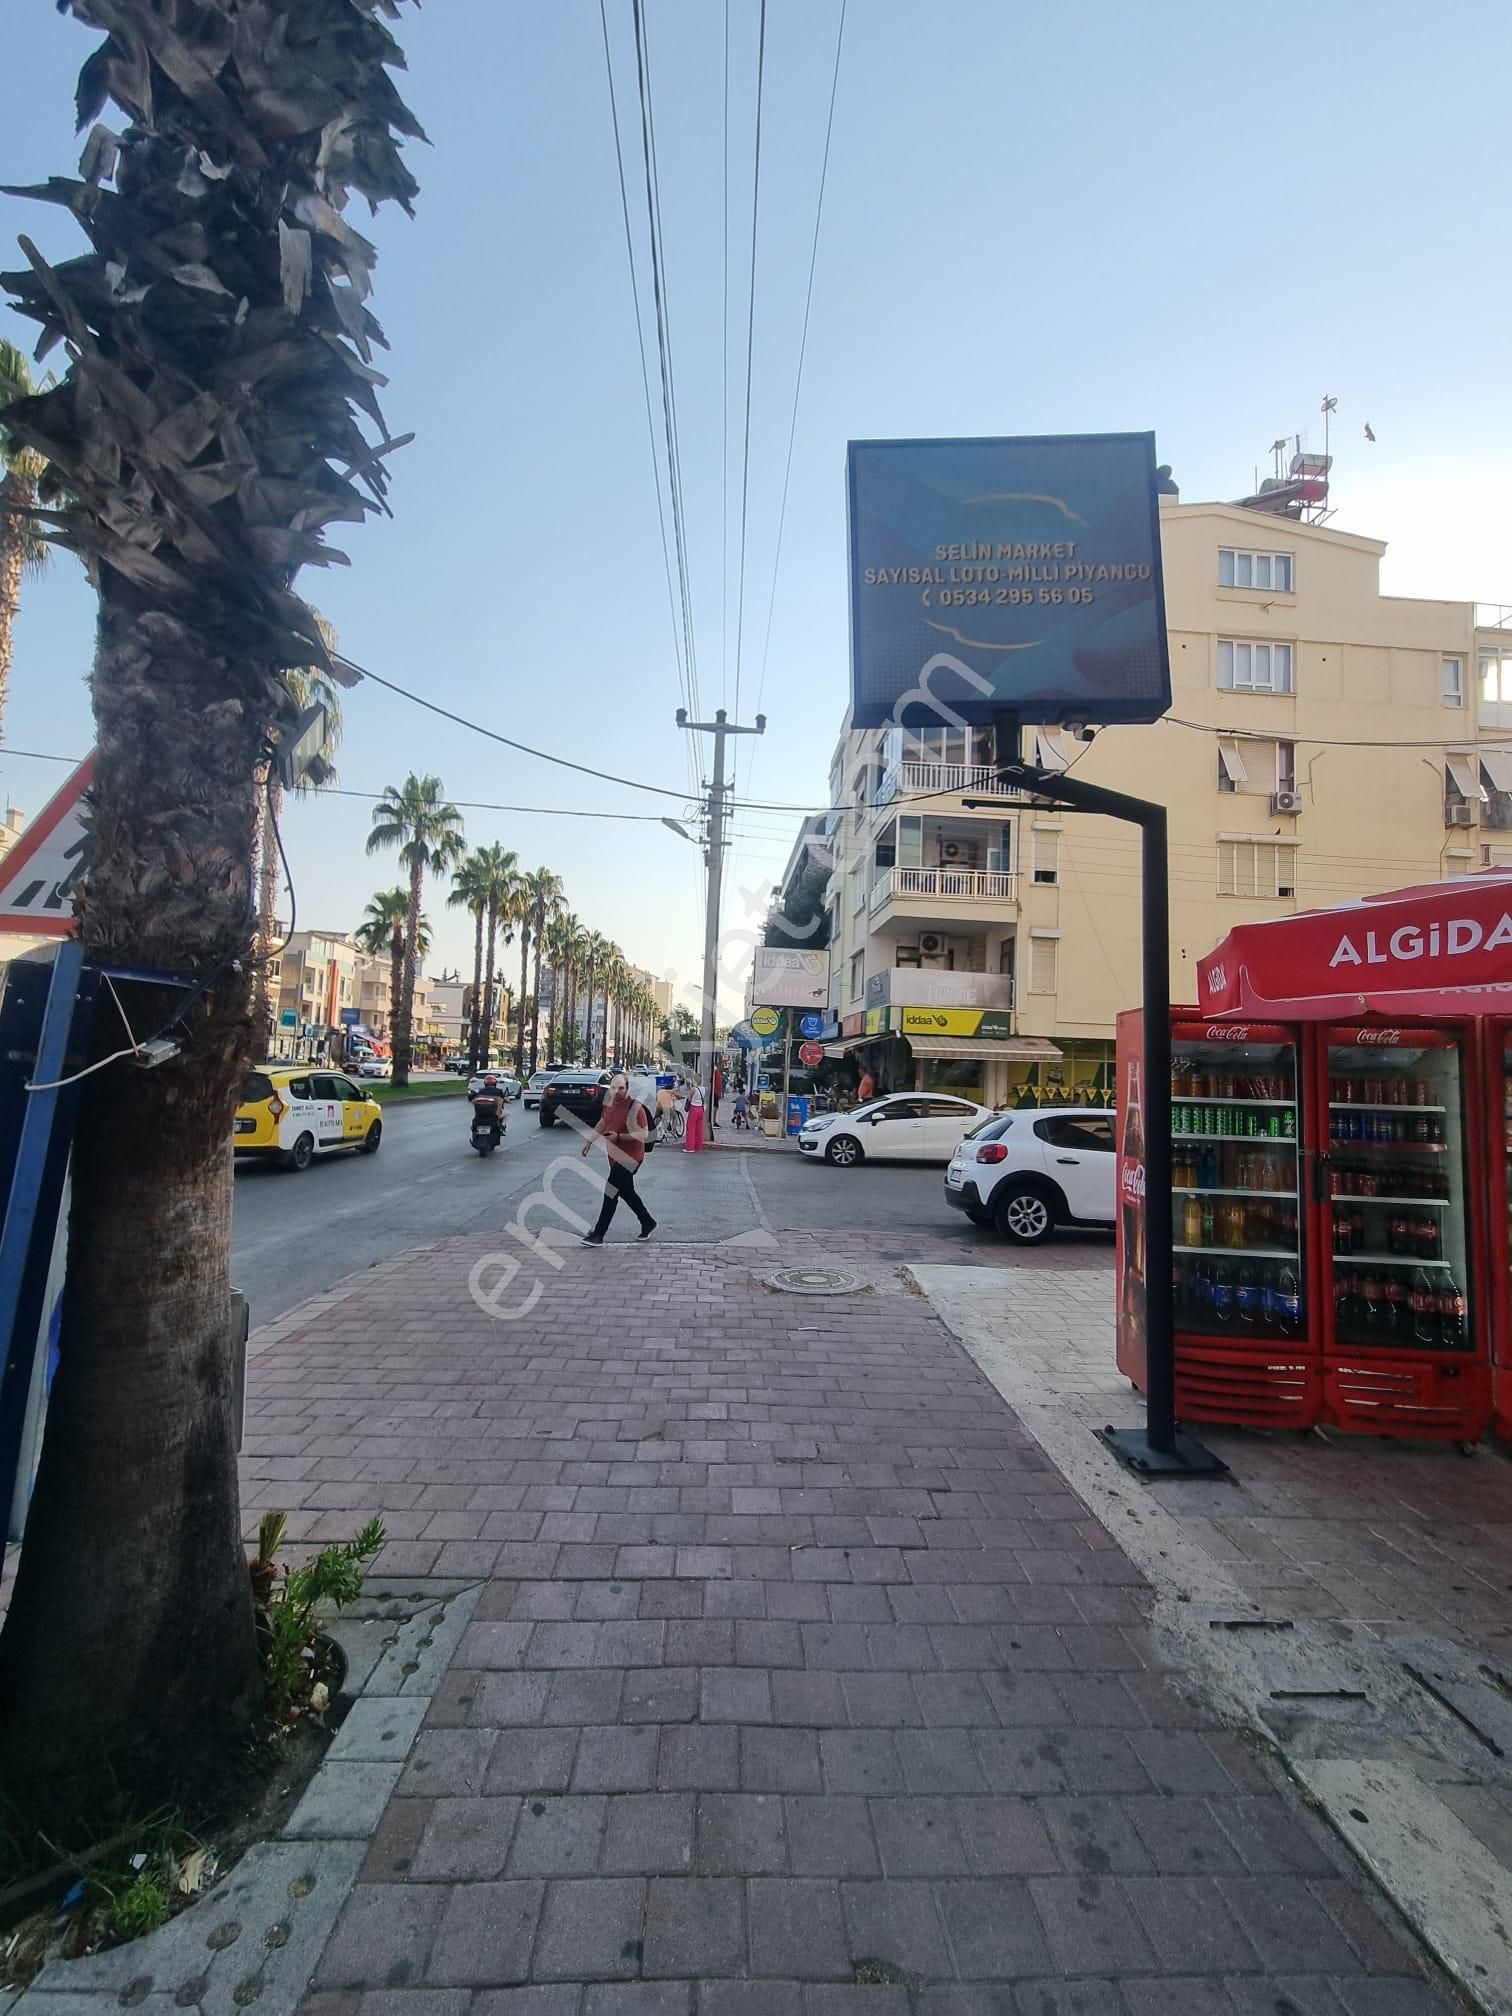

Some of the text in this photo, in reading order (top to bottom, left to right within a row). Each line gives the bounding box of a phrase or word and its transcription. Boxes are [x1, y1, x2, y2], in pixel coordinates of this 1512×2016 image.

[997, 542, 1077, 560] MARKET
[864, 567, 945, 585] SAYISAL
[1065, 560, 1151, 581] PİYANGO
[940, 589, 992, 606] 0534
[996, 588, 1034, 606] 295
[1038, 588, 1063, 605] 56
[1068, 587, 1094, 605] 05
[763, 952, 800, 968] iddaa
[906, 1015, 932, 1025] iddaa
